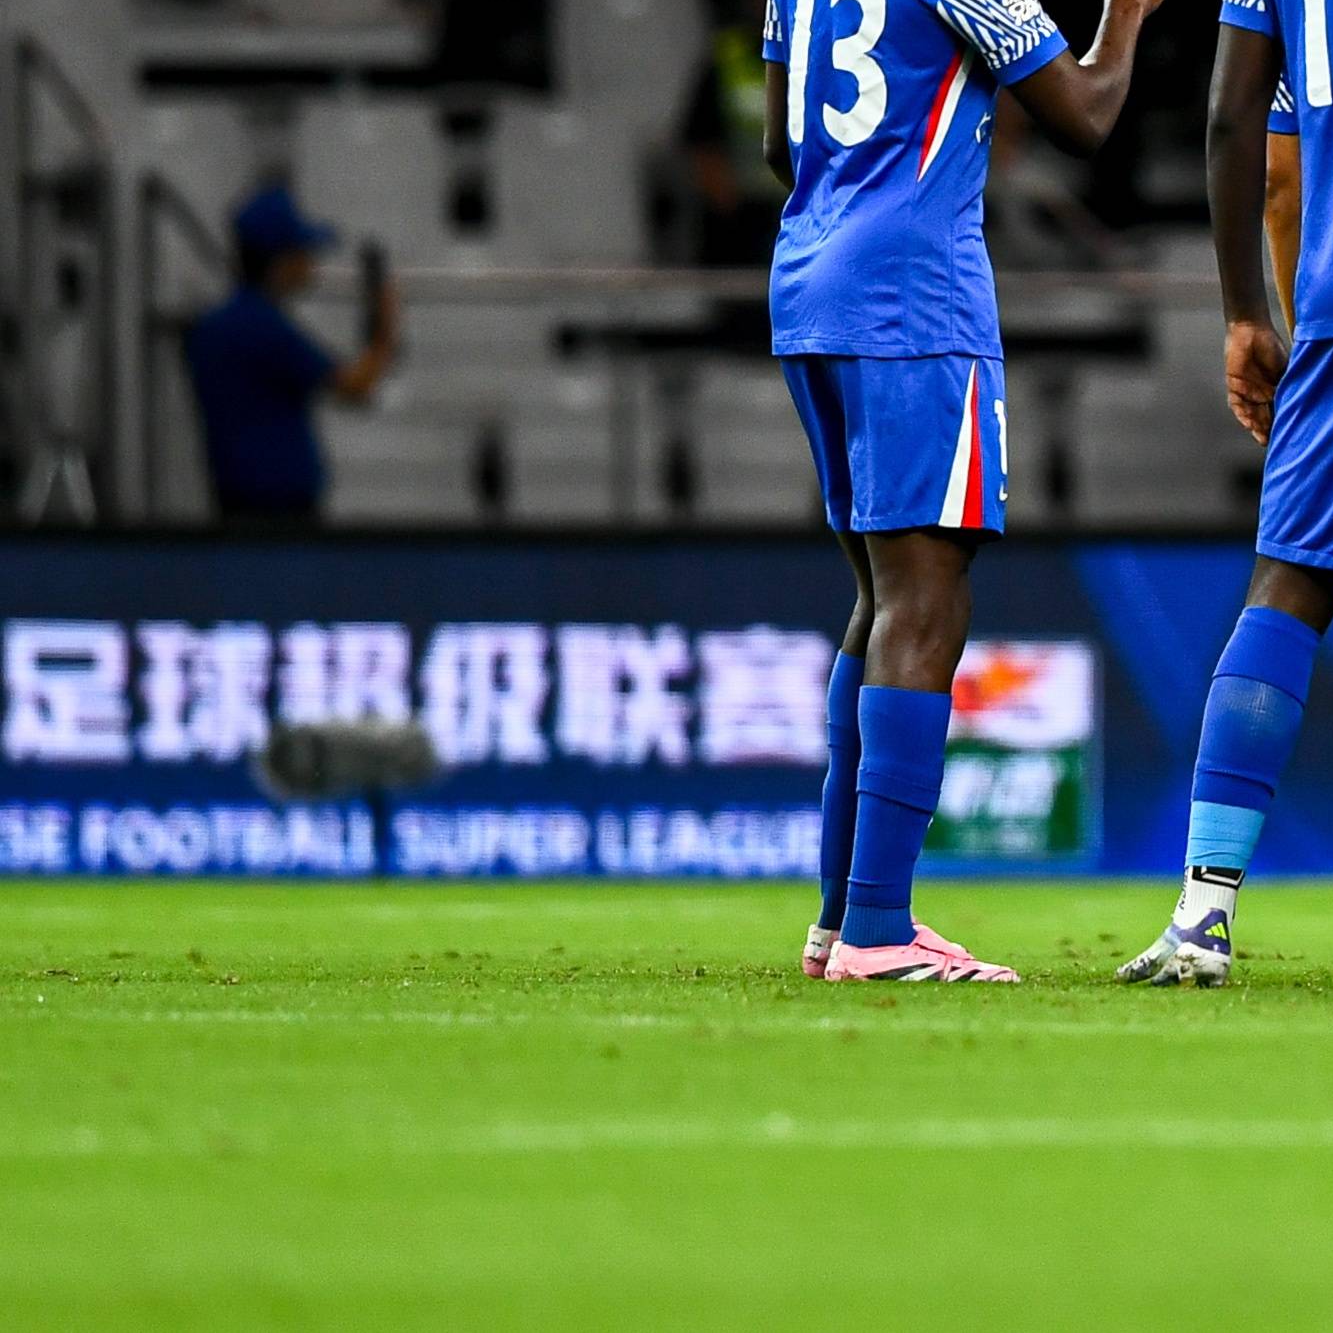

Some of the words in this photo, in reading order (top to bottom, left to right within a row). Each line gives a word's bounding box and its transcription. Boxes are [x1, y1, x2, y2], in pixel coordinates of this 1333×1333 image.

[80, 806, 374, 871] FOOTBALL
[394, 808, 591, 874] SUPER
[600, 810, 823, 875] LEAGUE
